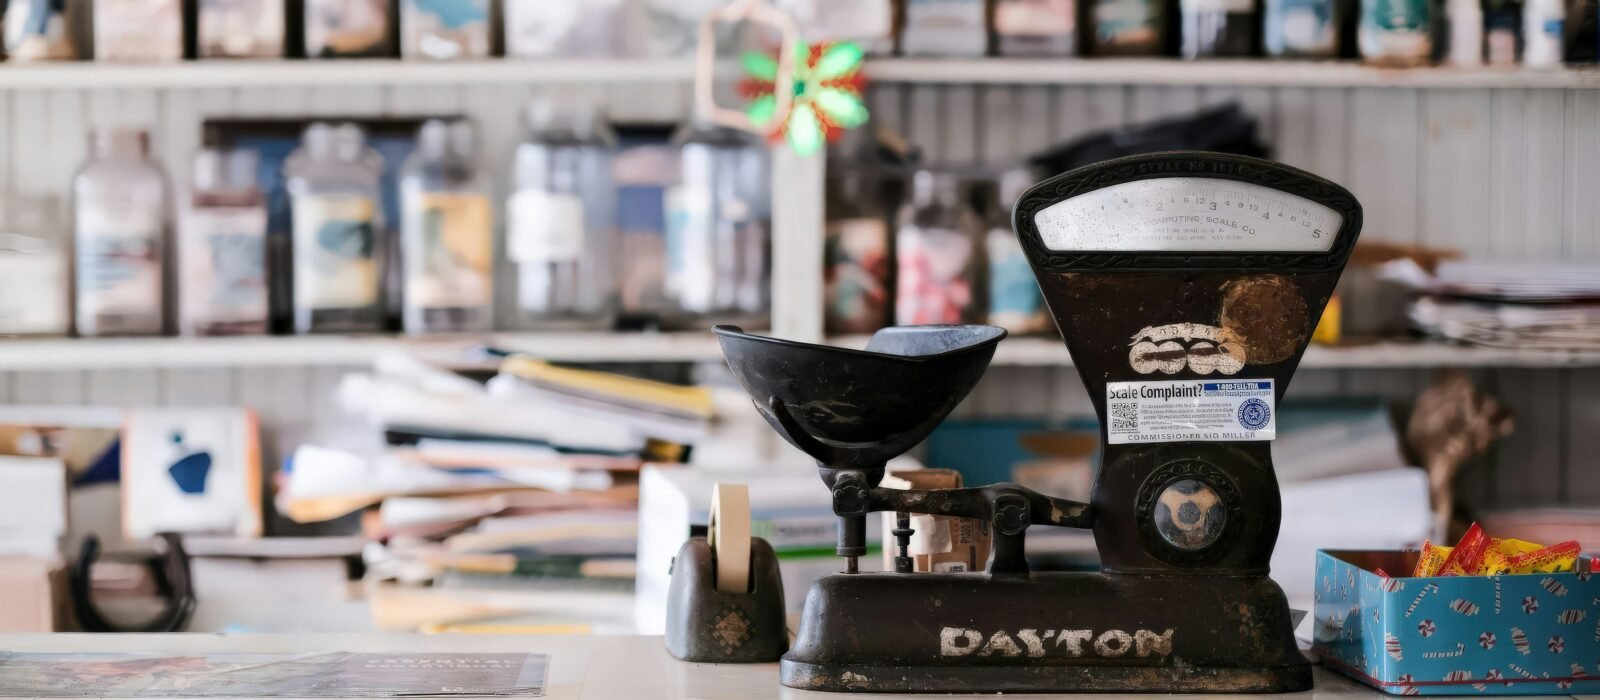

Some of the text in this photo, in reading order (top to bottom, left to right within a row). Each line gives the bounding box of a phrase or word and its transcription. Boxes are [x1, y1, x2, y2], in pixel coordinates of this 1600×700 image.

[1144, 216, 1200, 226] COMPUTING
[1206, 217, 1238, 228] SCALE
[1195, 197, 1205, 205] 12
[1209, 202, 1217, 211] 3
[1250, 204, 1259, 212] 12
[1262, 211, 1270, 220] 4
[1313, 229, 1321, 239] 5
[1109, 385, 1138, 399] Scale
[1140, 384, 1202, 402] Complaint?
[1128, 431, 1257, 441] COMMISSIONER SID MILLER
[939, 626, 1175, 657] DAYTON
